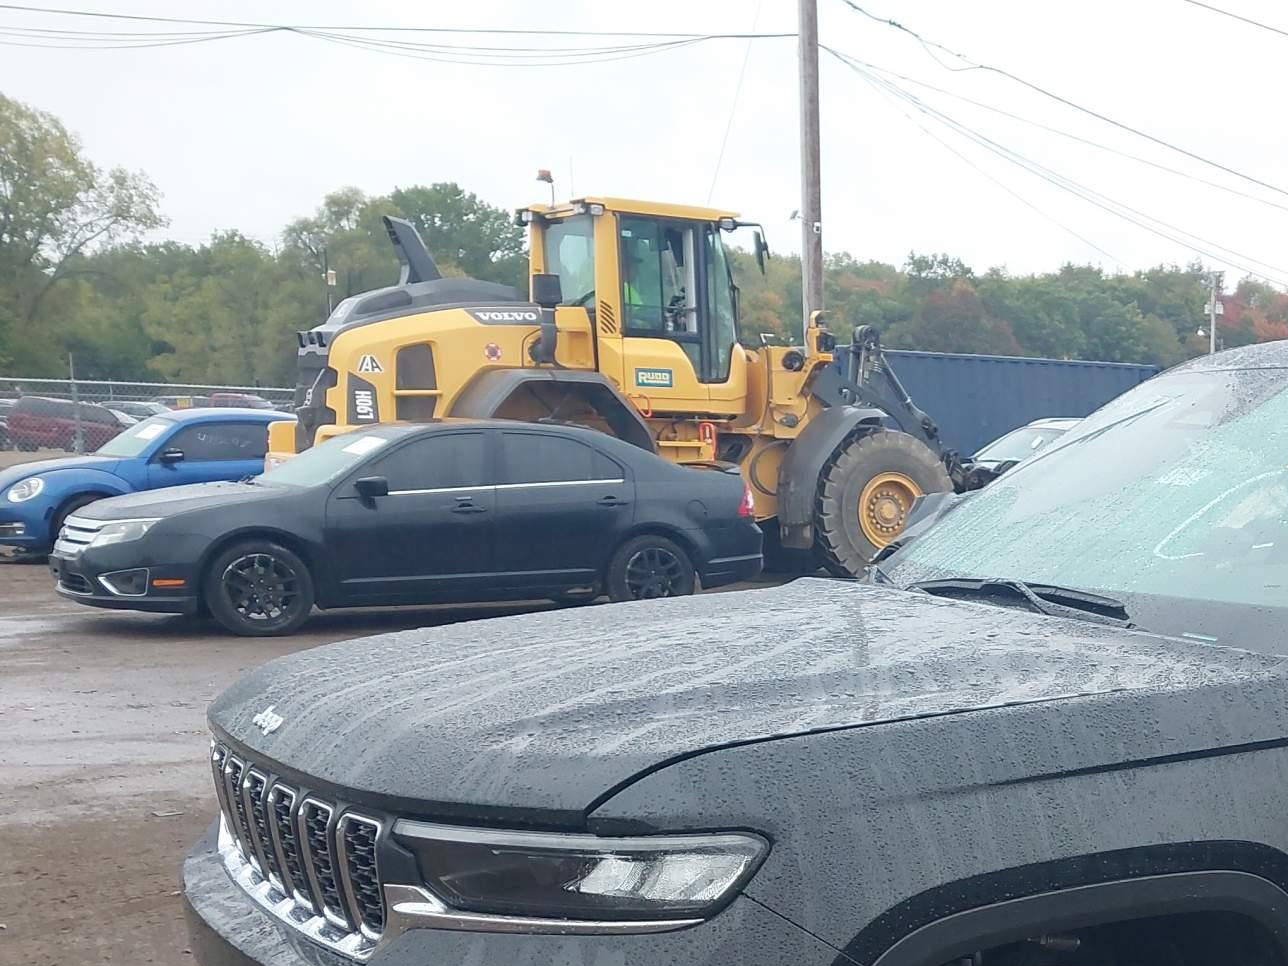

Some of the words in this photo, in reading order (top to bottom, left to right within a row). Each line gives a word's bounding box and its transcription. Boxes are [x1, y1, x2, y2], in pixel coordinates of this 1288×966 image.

[475, 311, 538, 321] VOLVO
[354, 390, 374, 419] L90H
[252, 704, 284, 736] Jeep
